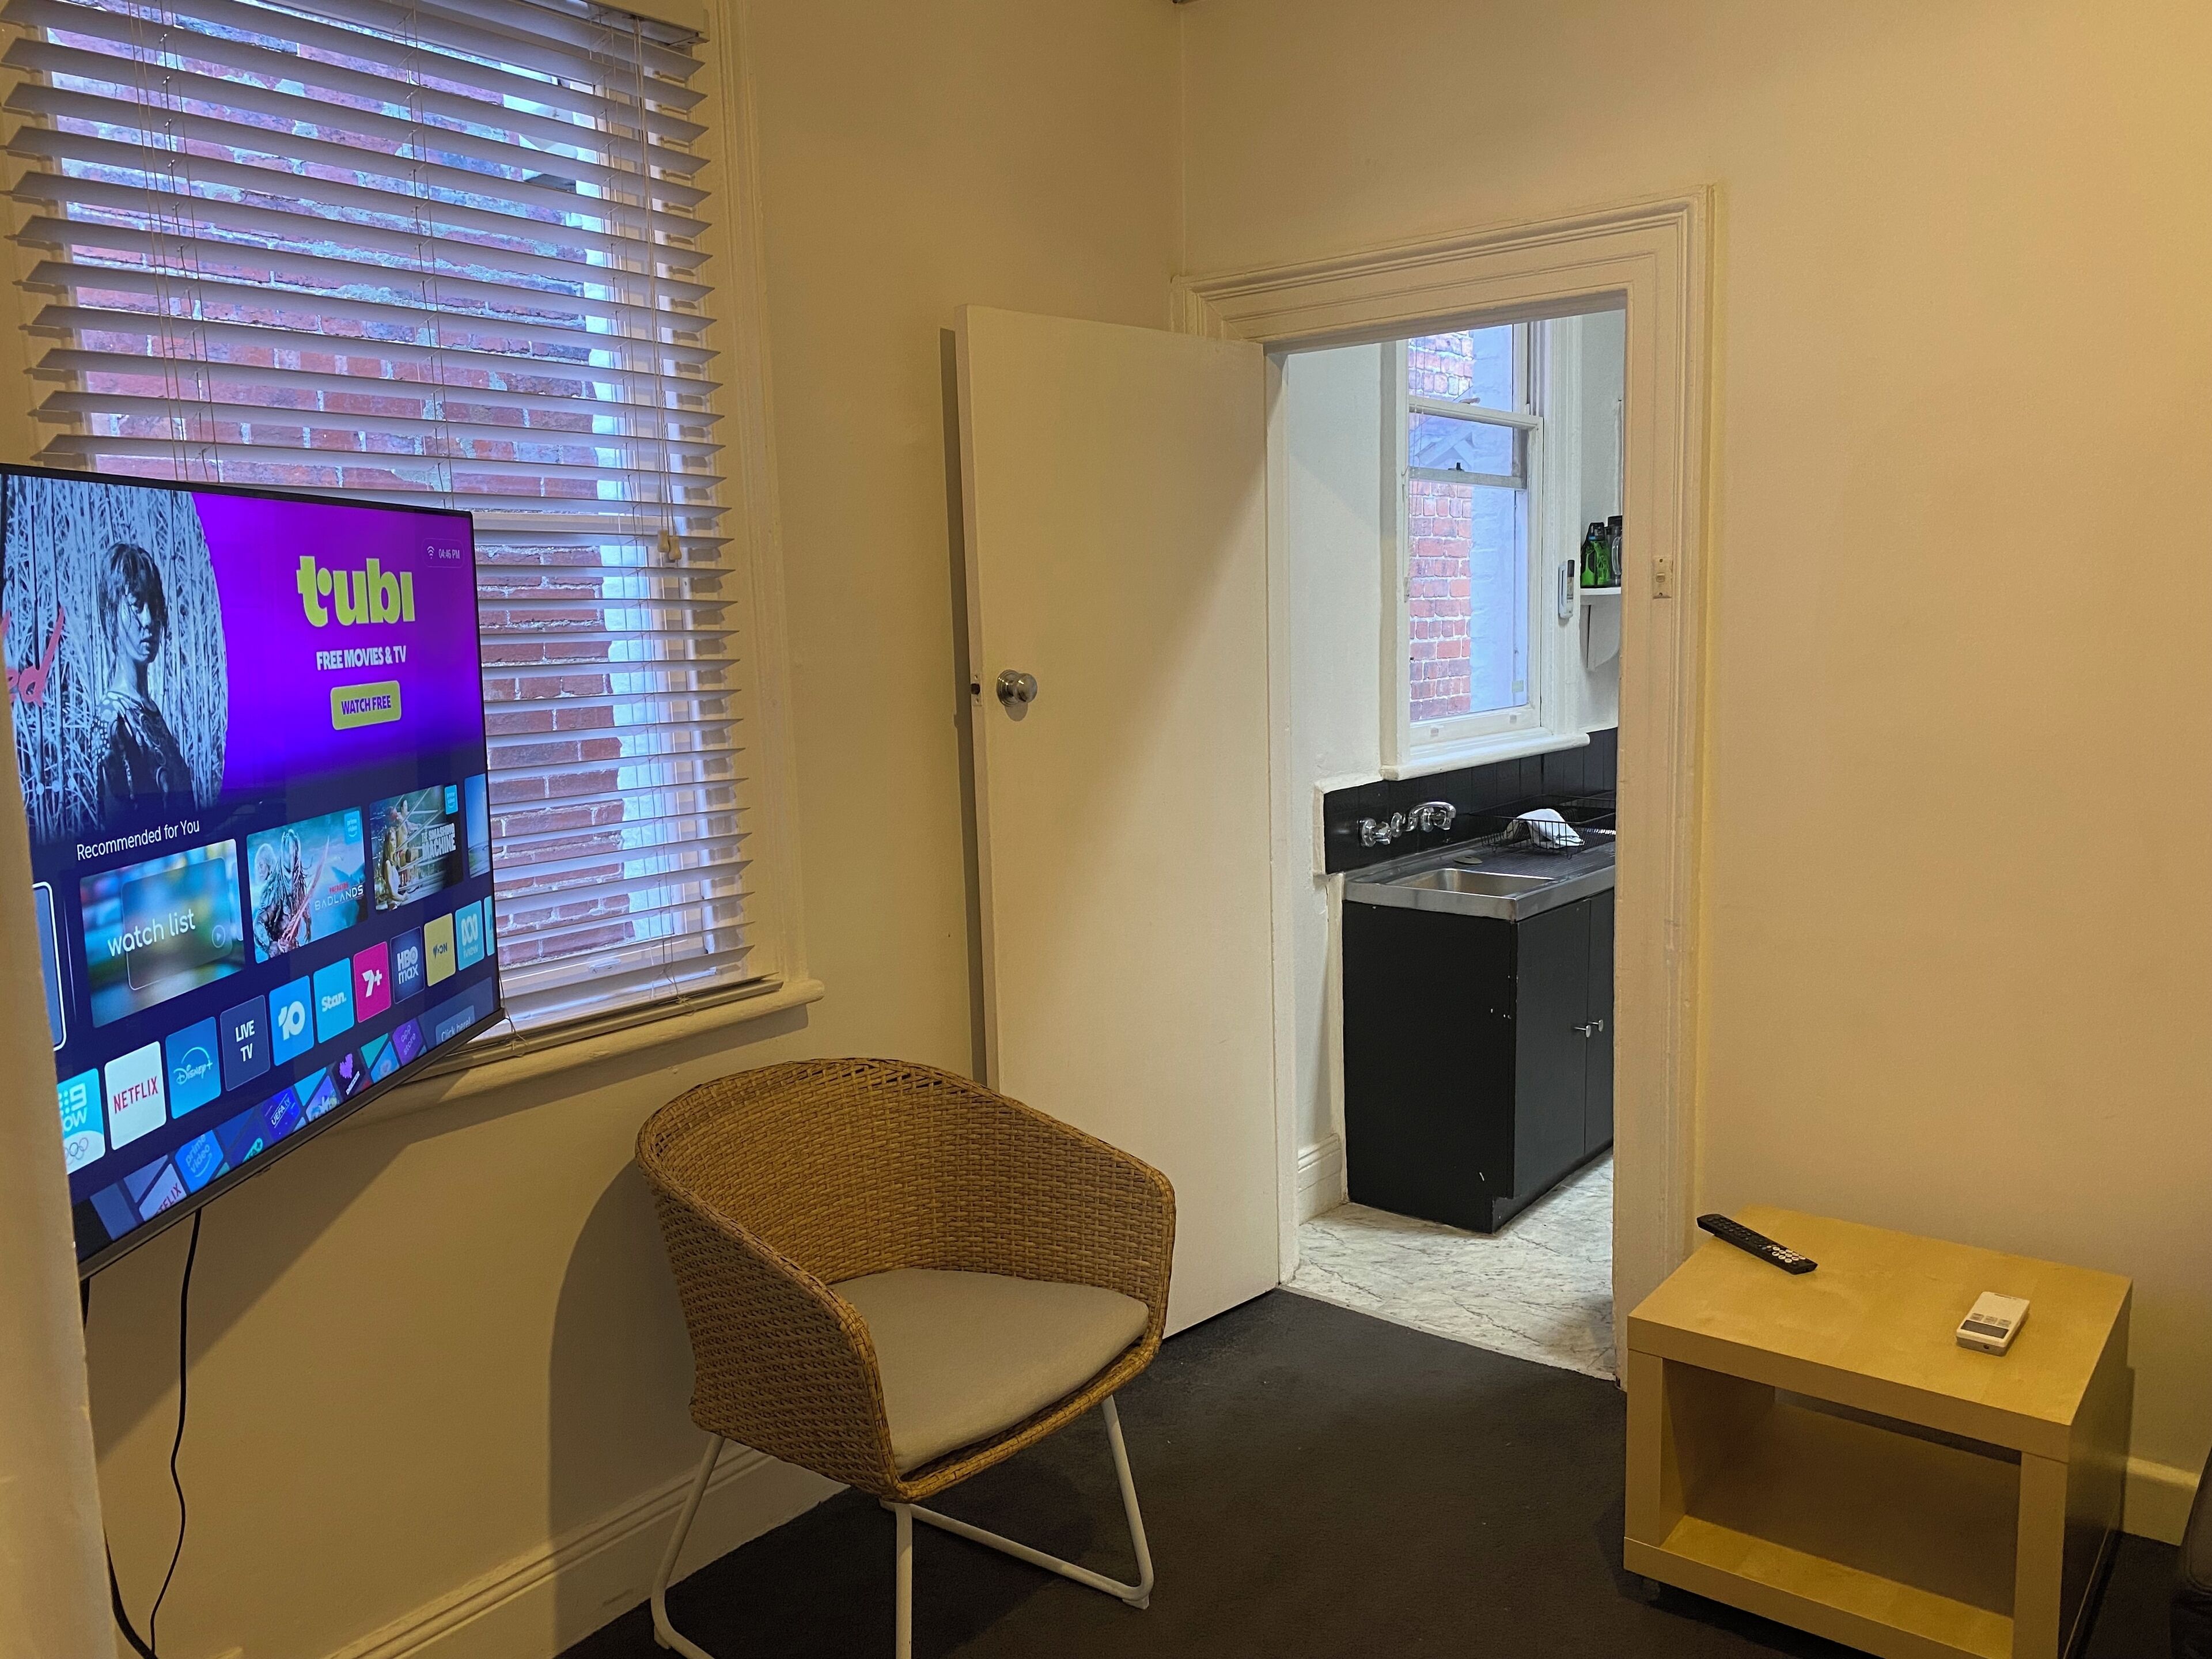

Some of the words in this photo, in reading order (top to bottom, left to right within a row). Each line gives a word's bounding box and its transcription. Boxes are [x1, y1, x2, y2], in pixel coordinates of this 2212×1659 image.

[452, 549, 460, 559] PM
[296, 556, 415, 627] tubi
[316, 650, 343, 671] FREE
[344, 647, 384, 668] MOVIES
[385, 646, 393, 664] &
[393, 645, 407, 662] TV
[341, 698, 370, 715] WATCH
[372, 695, 392, 711] FREE
[77, 827, 162, 861] Recommended
[164, 824, 177, 839] for
[180, 820, 200, 835] You
[422, 834, 456, 859] MACHINE
[315, 884, 364, 911] BADLANDS
[107, 918, 165, 957] watch
[169, 908, 196, 937] list
[397, 946, 418, 970] HBO
[398, 964, 419, 985] max
[321, 992, 347, 1013] Stan.
[235, 1020, 255, 1043] LIVE
[278, 1001, 305, 1040] 10
[401, 1024, 411, 1043] app
[404, 1033, 416, 1056] store
[441, 1027, 456, 1042] Click
[240, 1043, 253, 1062] TV
[113, 1075, 158, 1114] NETFLIX
[185, 1133, 207, 1167] prime
[191, 1144, 210, 1173] video
